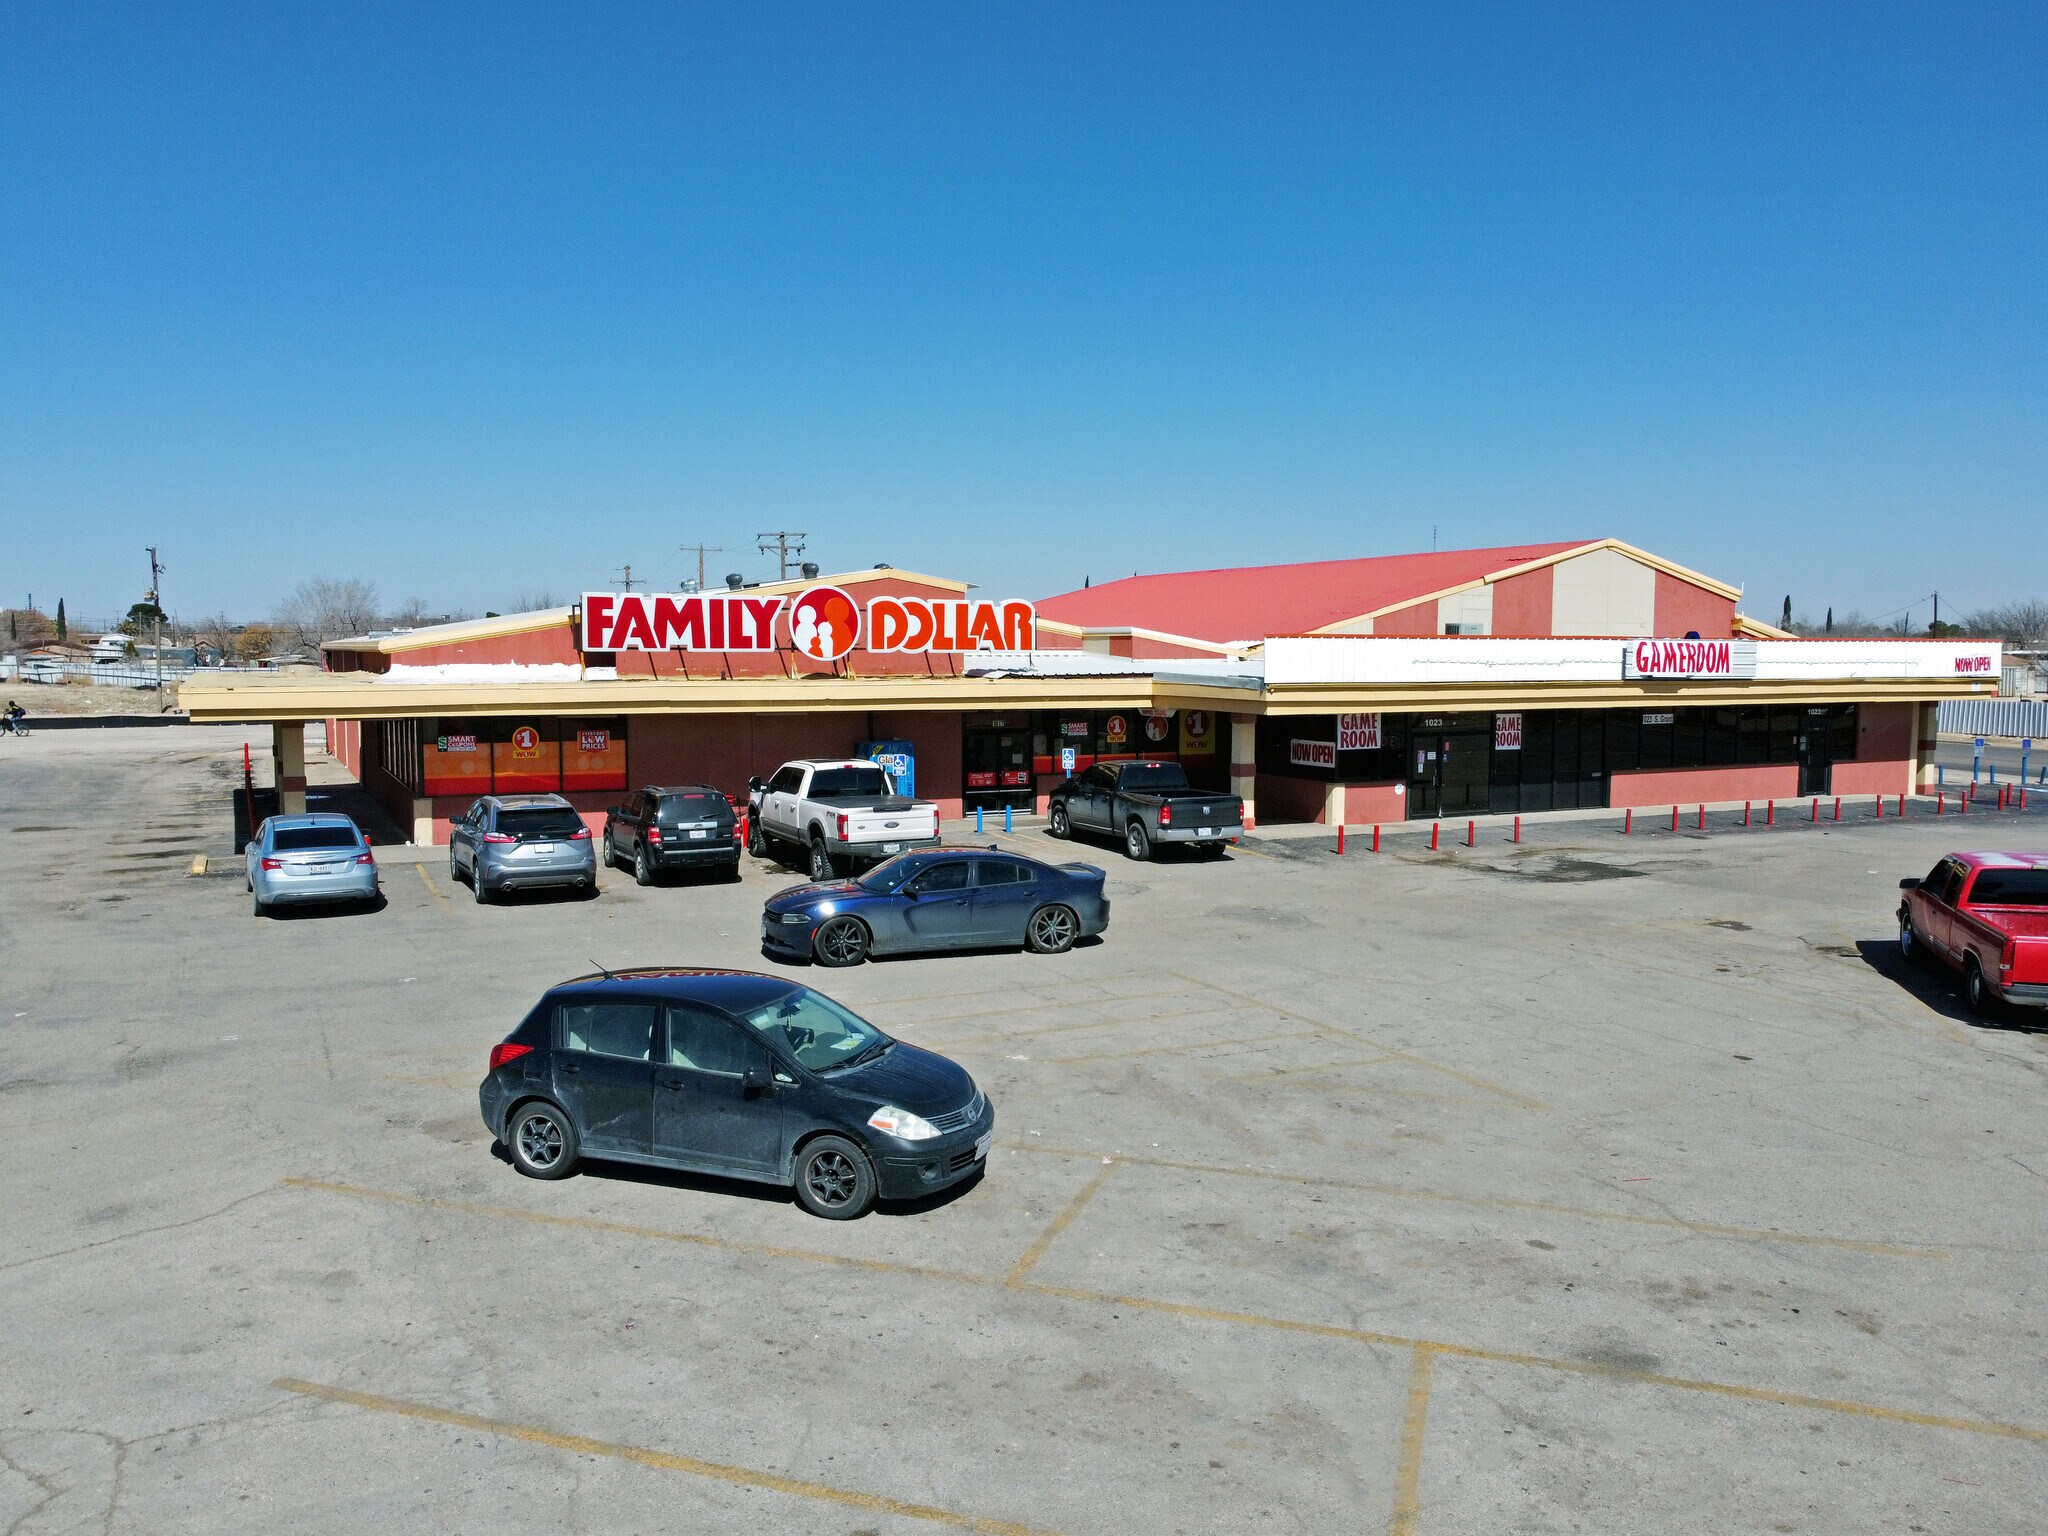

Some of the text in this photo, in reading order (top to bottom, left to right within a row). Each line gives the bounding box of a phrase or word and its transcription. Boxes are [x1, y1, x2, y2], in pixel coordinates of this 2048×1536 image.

[586, 595, 1033, 651] FAMILY DOLLAR
[1636, 641, 1730, 673] GAMEROOM
[1955, 656, 1991, 672] NOW OPEN
[1341, 713, 1378, 730] GAME
[1425, 718, 1443, 727] 1023
[1495, 717, 1521, 731] GAME
[516, 730, 533, 748] $1
[581, 735, 605, 743] LOW
[1341, 730, 1378, 748] ROOM
[1495, 732, 1521, 746] ROOM
[1292, 742, 1334, 764] NOW OPEN
